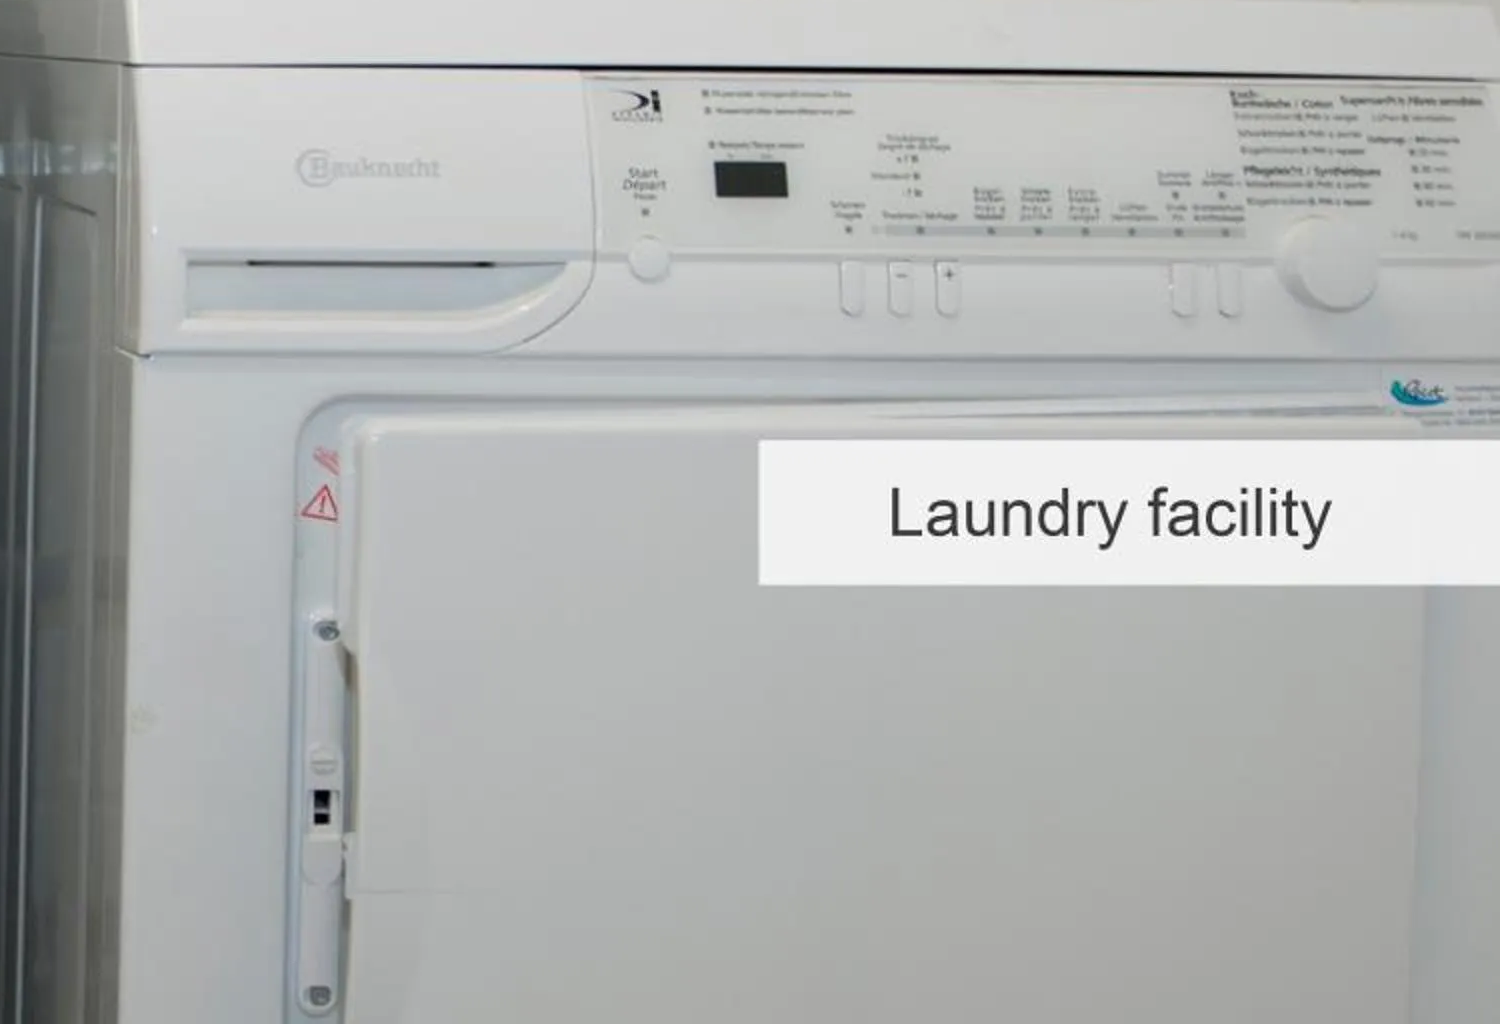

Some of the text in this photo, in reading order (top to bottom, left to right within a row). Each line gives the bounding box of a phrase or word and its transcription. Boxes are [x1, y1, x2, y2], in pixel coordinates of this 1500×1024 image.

[295, 148, 441, 187] Bauknecht
[628, 167, 660, 180] Start
[622, 179, 667, 192] Départ
